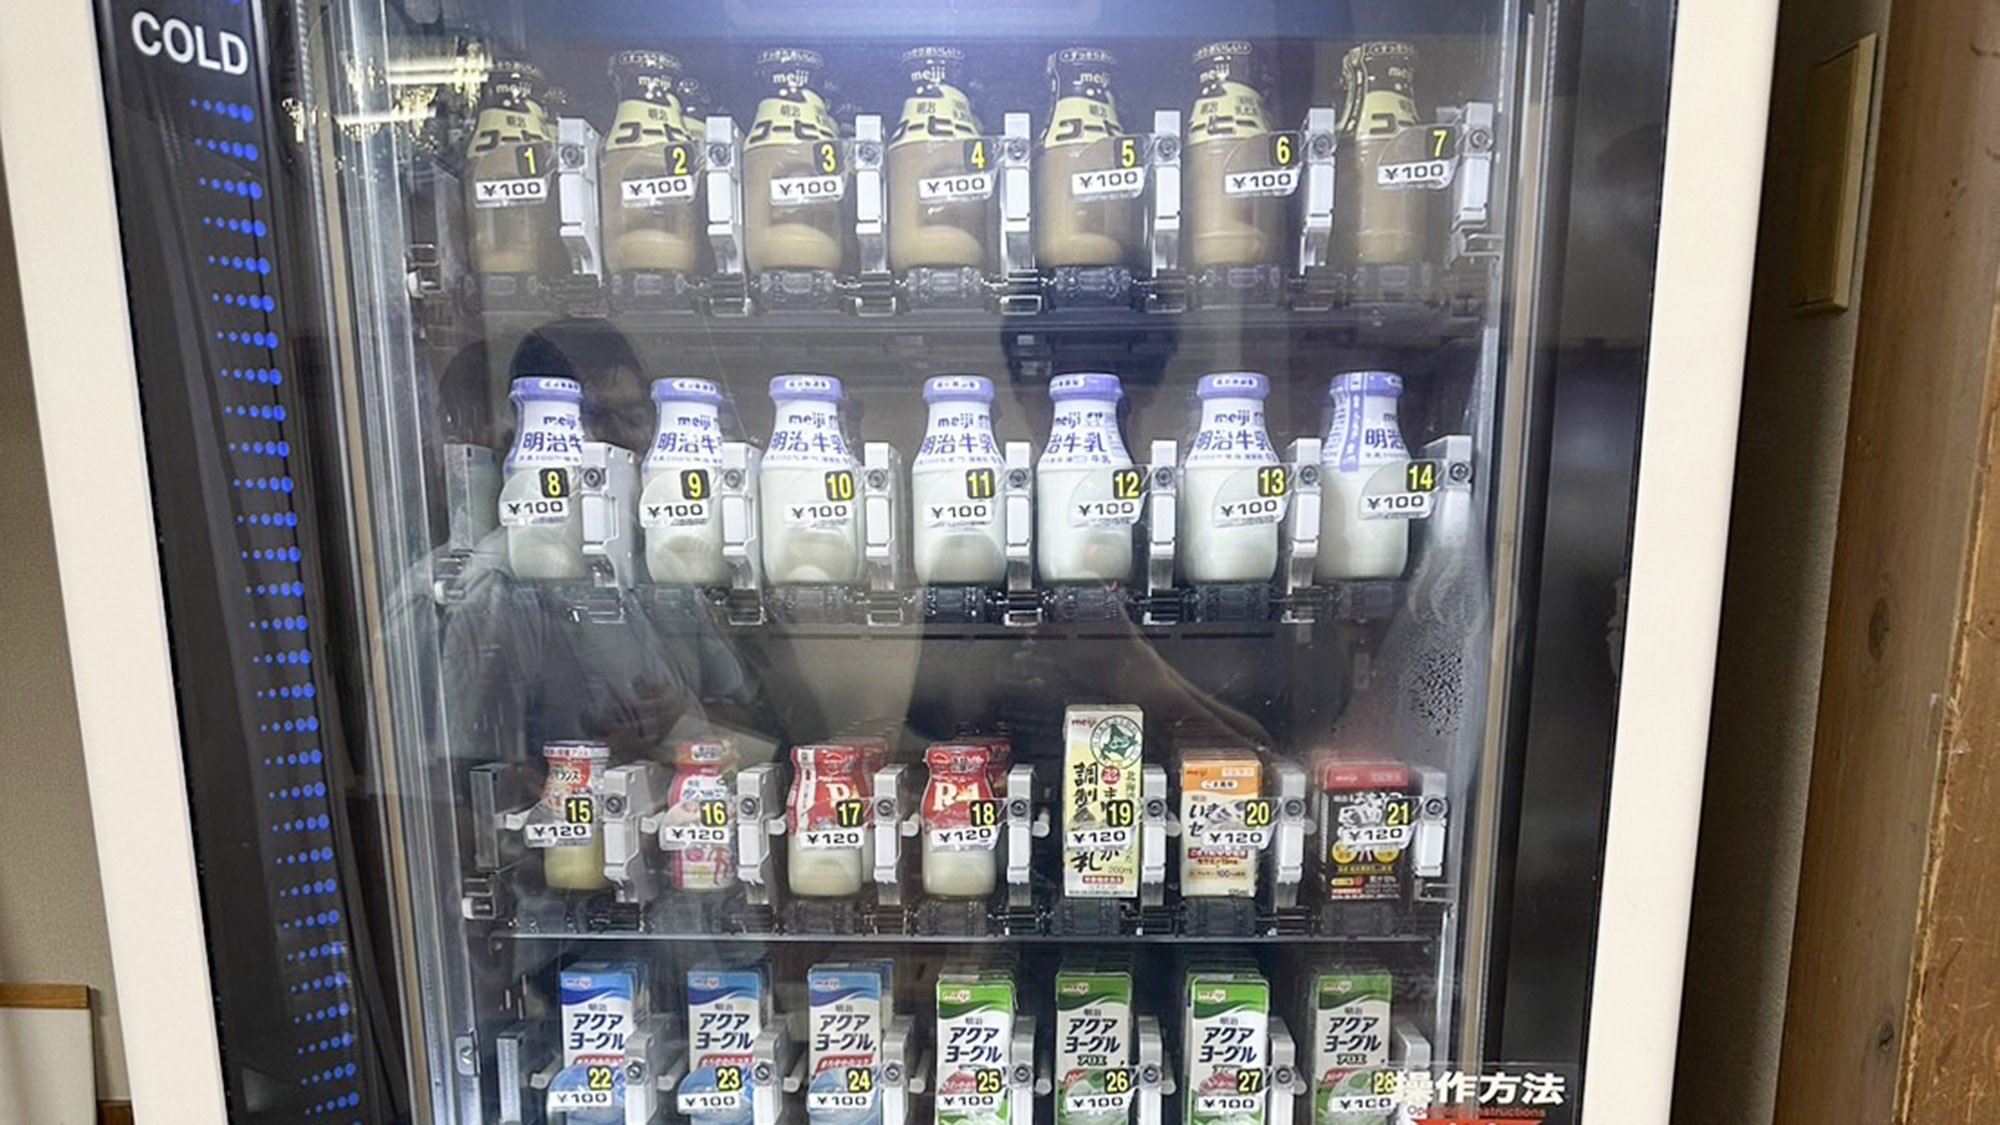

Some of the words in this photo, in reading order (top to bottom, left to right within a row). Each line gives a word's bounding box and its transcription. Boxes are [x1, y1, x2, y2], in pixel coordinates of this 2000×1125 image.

[131, 11, 248, 75] COLD
[773, 69, 809, 87] meiji
[911, 66, 945, 84] meiji
[749, 119, 834, 144] コーヒー
[889, 115, 974, 141] コーヒー
[1189, 115, 1259, 135] ーヒー
[1277, 136, 1291, 164] 6
[1433, 130, 1447, 157] 7
[524, 147, 536, 175] 1
[672, 148, 688, 175] 2
[820, 144, 836, 172] 3
[971, 141, 985, 169] 4
[1121, 140, 1136, 168] 5
[1079, 171, 1138, 188] ¥100
[1385, 163, 1443, 180] ¥100
[483, 181, 541, 197] ¥100
[629, 179, 687, 196] ¥100
[778, 179, 837, 196] ¥100
[926, 177, 985, 194] ¥100
[1233, 173, 1292, 189] ¥100
[677, 414, 711, 431] meiji
[789, 412, 825, 429] meiji
[938, 413, 973, 429] meiji
[1215, 410, 1250, 426] meiji
[657, 431, 722, 454] 明治牛
[771, 430, 850, 454] 明治牛乳
[923, 433, 999, 455] 明治牛乳
[1196, 429, 1273, 453] 明治牛乳
[547, 471, 561, 496] 8
[687, 472, 702, 497] 9
[827, 473, 852, 499] 10
[968, 472, 992, 497] 11
[1114, 472, 1140, 497] 12
[1260, 469, 1286, 496] 13
[1409, 464, 1434, 490] 14
[508, 500, 563, 515] ¥100
[647, 503, 704, 518] ¥100
[931, 504, 987, 518] ¥100
[1079, 501, 1135, 517] ¥100
[1221, 499, 1278, 516] ¥100
[1367, 495, 1425, 510] ¥100
[792, 505, 848, 519] ¥100
[933, 782, 980, 812] R-1
[567, 800, 592, 824] 15
[702, 802, 727, 827] 16
[838, 803, 861, 826] 17
[972, 803, 995, 826] 18
[1109, 802, 1132, 827] 19
[1247, 802, 1270, 825] 20
[1387, 802, 1409, 825] 21
[533, 825, 587, 839] ¥120
[672, 828, 726, 841] ¥120
[807, 833, 860, 845] ¥120
[938, 829, 992, 844] ¥120
[1073, 830, 1126, 843] ¥120
[1209, 832, 1263, 844] ¥120
[1349, 828, 1403, 842] ¥120
[573, 1013, 624, 1031] アクア
[700, 1013, 750, 1031] アクア
[820, 1014, 871, 1032] アクア
[1069, 1019, 1118, 1035] アクア
[1329, 1017, 1379, 1034] アクア
[569, 1032, 626, 1050] ヨーグル
[695, 1032, 754, 1050] ヨーグル
[815, 1033, 874, 1051] ヨーグル
[950, 1027, 1000, 1044] アクア
[1064, 1036, 1121, 1053] ヨーグル
[1204, 1027, 1255, 1044] アクア
[1324, 1035, 1381, 1052] ヨーグル
[945, 1046, 1003, 1063] ヨーグル
[1077, 1054, 1107, 1066] アロエ
[1199, 1046, 1258, 1063] ヨーグル
[1336, 1053, 1367, 1065] アロエ
[588, 1067, 612, 1089] 22
[717, 1068, 740, 1090] 23
[848, 1070, 872, 1092] 24
[978, 1071, 1001, 1093] 25
[1106, 1071, 1129, 1093] 26
[1239, 1071, 1261, 1093] 27
[1397, 1071, 1566, 1105] 操作方法
[557, 1093, 607, 1104] ¥100
[685, 1096, 736, 1107] ¥100
[818, 1095, 867, 1106] ¥100
[943, 1096, 994, 1107] ¥100
[1073, 1097, 1124, 1108] ¥100
[1204, 1099, 1255, 1109] ¥100
[1340, 1098, 1392, 1110] ¥100
